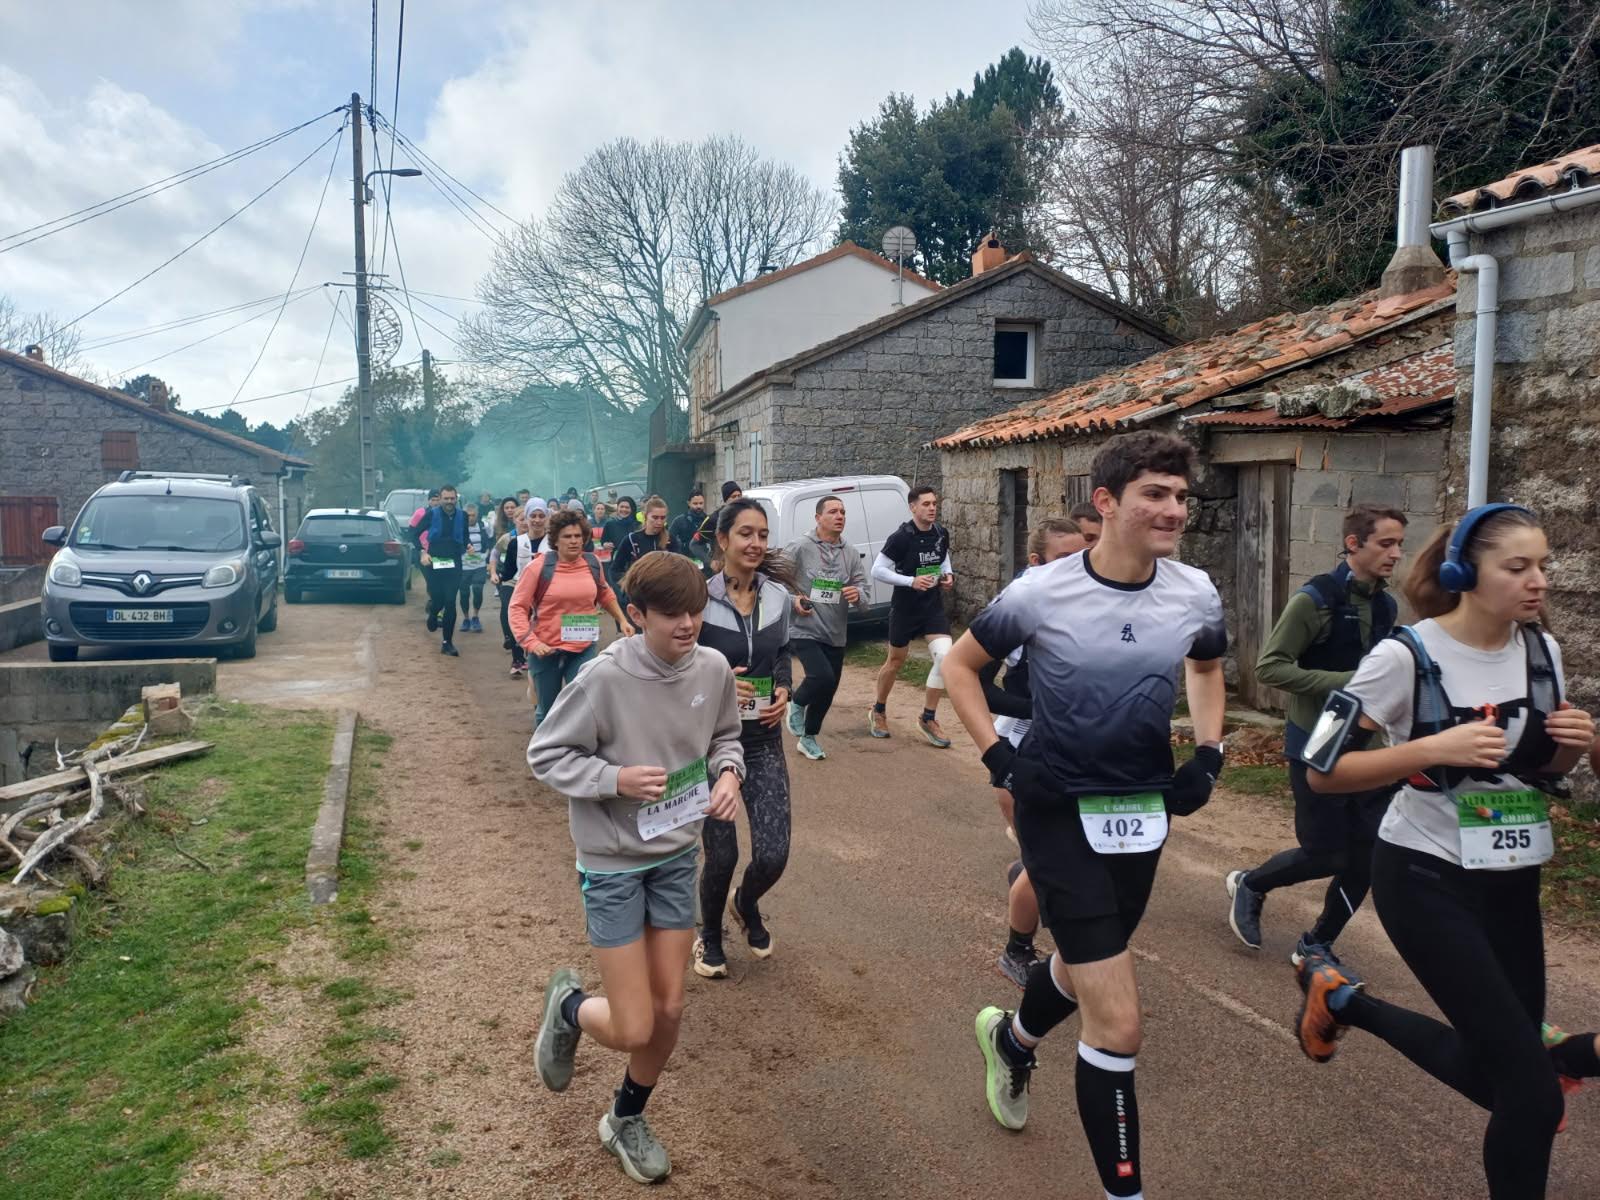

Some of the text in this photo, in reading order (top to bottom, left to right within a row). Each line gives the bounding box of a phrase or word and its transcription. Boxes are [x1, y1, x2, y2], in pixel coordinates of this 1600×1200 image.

[647, 805, 660, 817] LA
[664, 786, 701, 810] MARCHE
[1102, 818, 1145, 837] 402
[1491, 828, 1531, 850] 255
